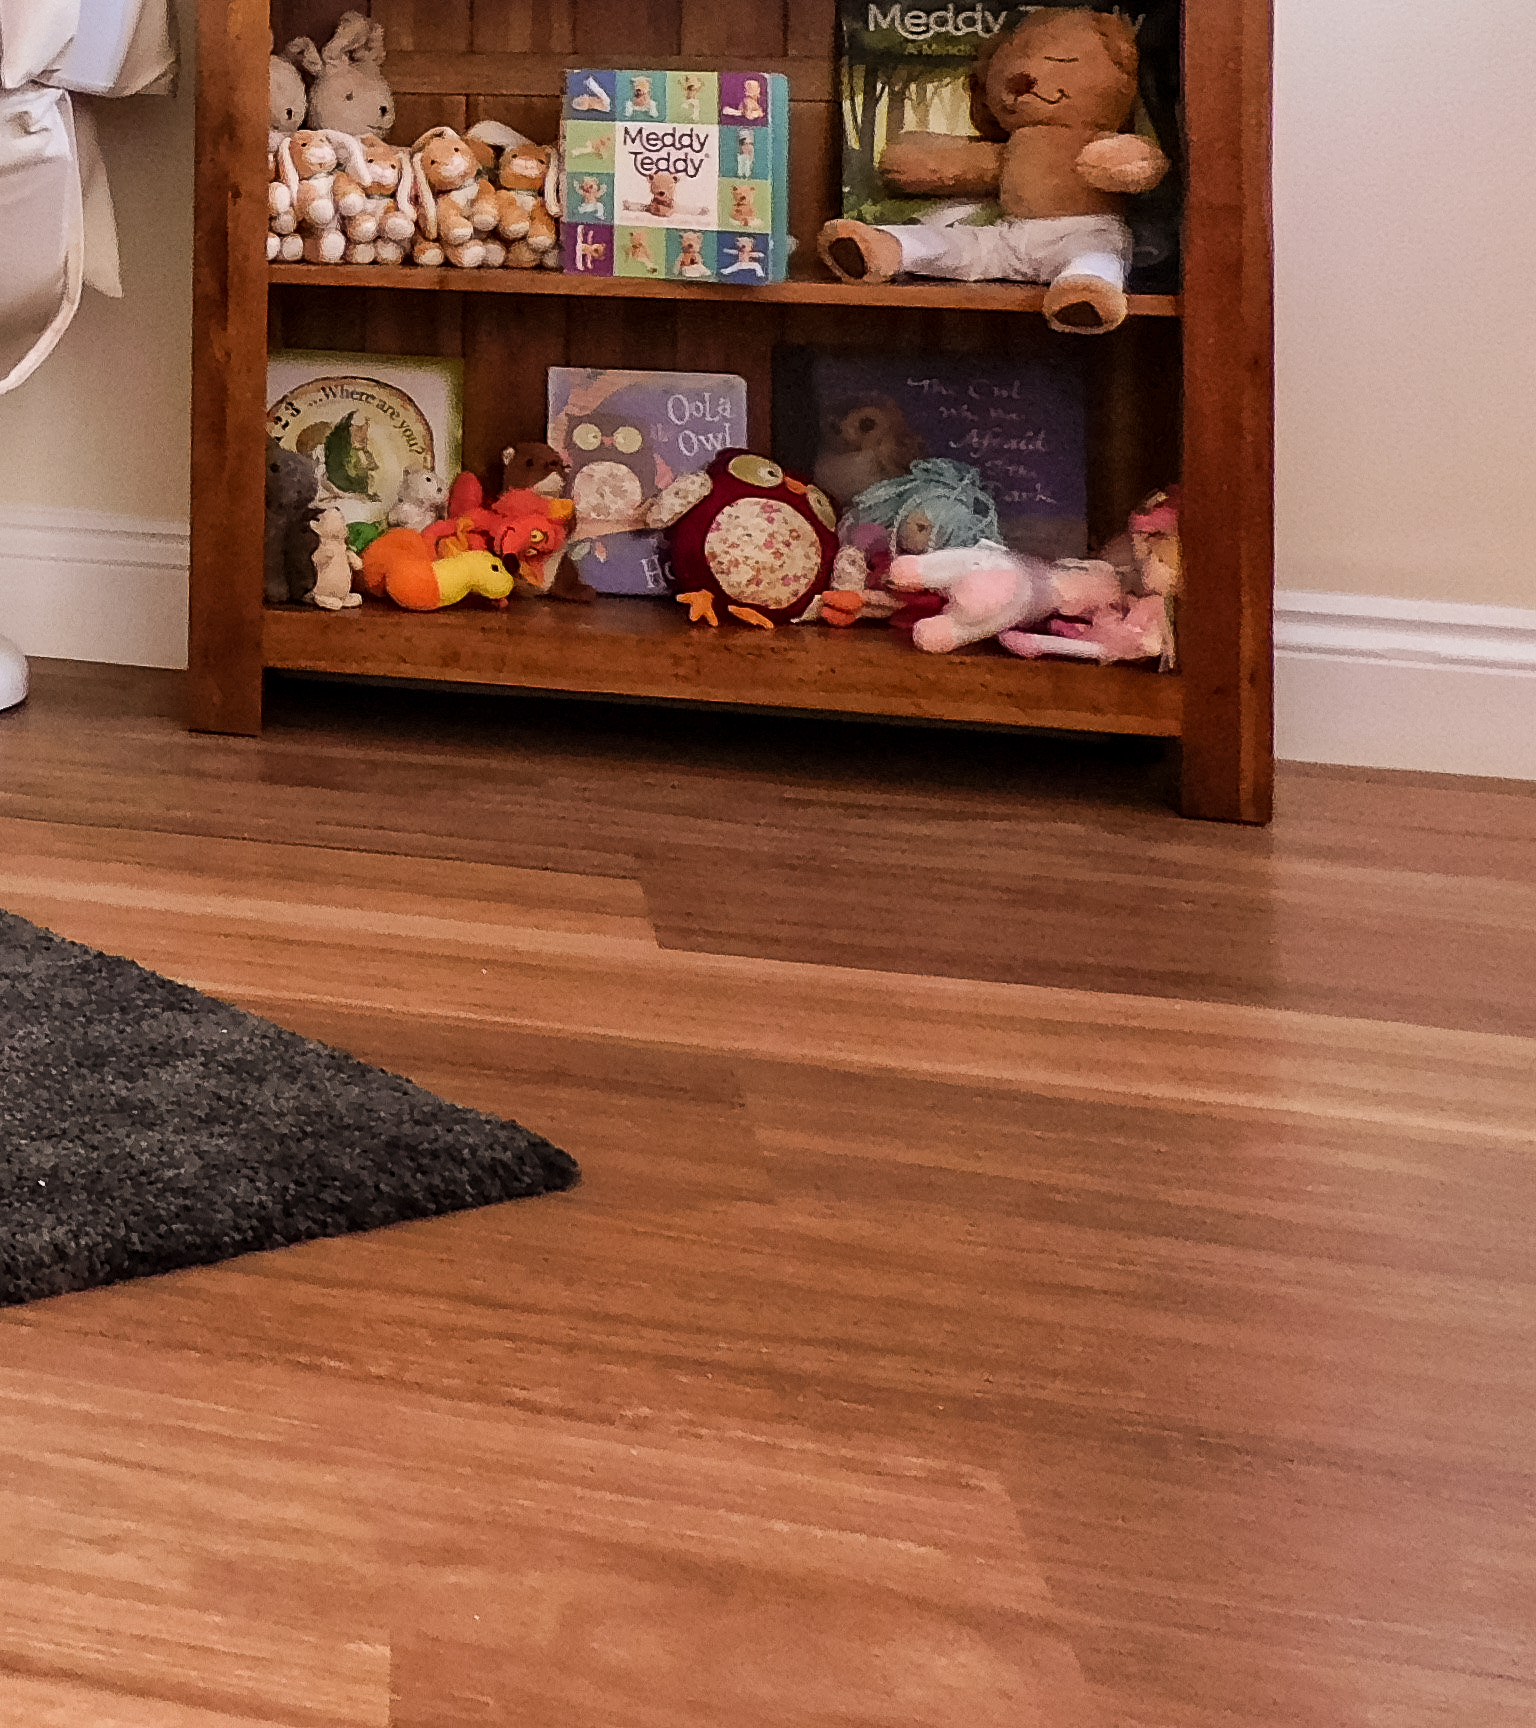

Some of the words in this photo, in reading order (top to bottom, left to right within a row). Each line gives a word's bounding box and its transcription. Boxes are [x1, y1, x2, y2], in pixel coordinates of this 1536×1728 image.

[868, 2, 1008, 40] Meddy
[623, 126, 710, 153] Meddy
[628, 151, 705, 178] Teddy
[678, 422, 732, 456] Owl
